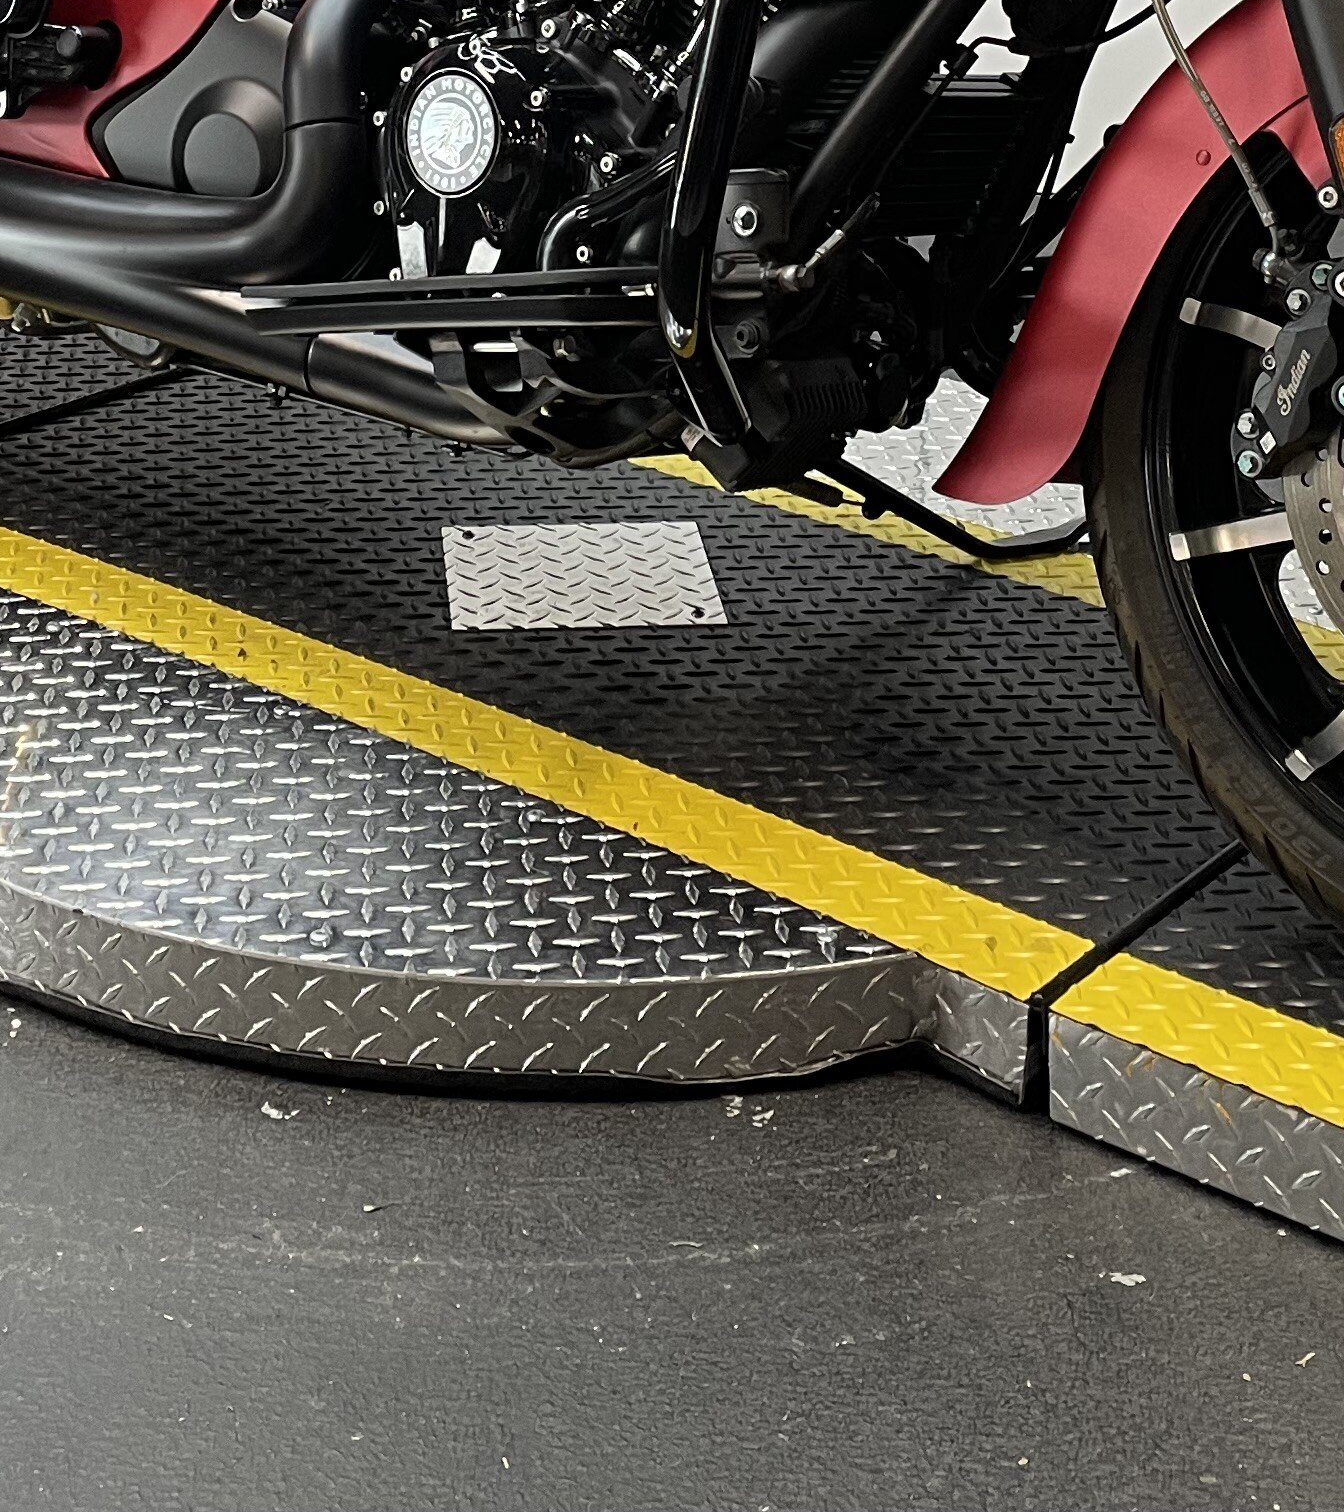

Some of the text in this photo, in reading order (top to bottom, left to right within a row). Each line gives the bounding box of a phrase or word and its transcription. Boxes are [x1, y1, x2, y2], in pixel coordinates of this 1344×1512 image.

[409, 78, 494, 178] INDIAN MOTORCYCLE
[1276, 349, 1311, 416] Indian
